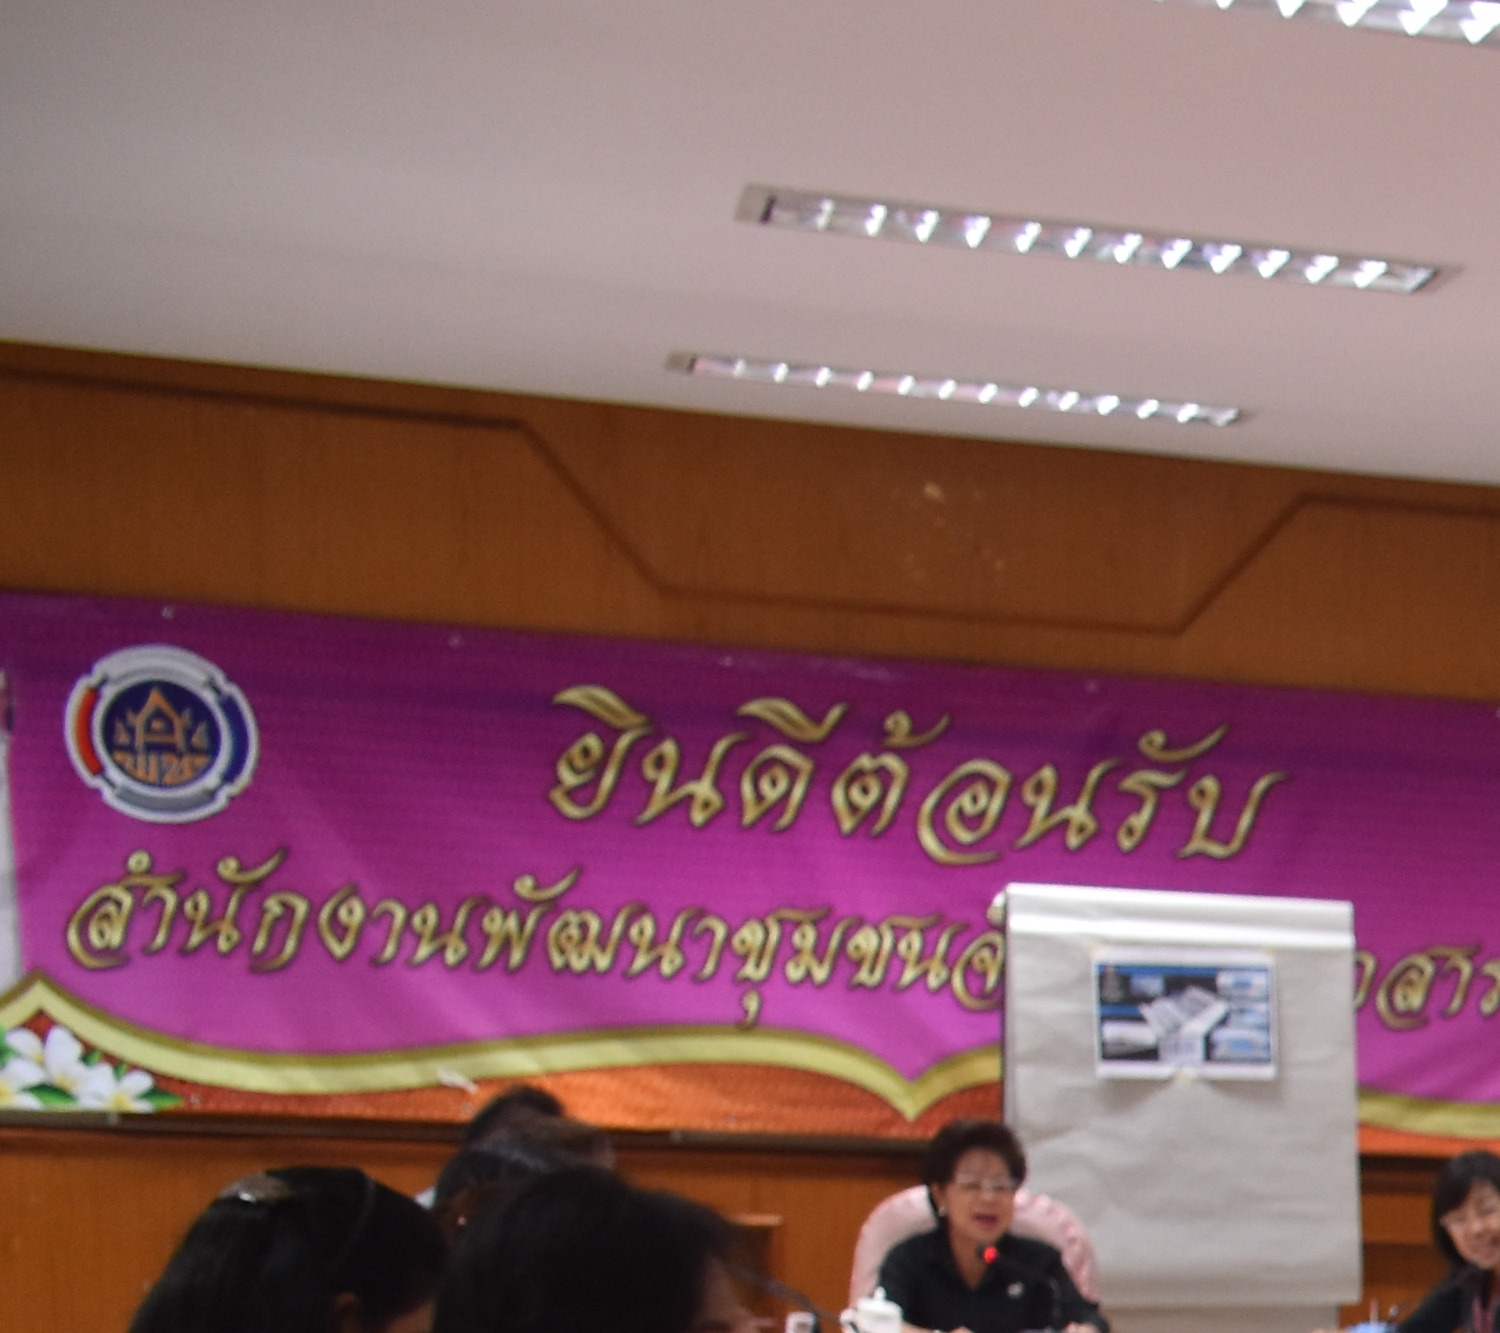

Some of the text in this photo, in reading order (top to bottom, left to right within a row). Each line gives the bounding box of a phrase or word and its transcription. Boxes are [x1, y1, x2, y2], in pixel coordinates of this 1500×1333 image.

[548, 684, 1289, 866] ยินดีต้อนรับ
[66, 847, 1006, 1029] สำนักงานพัฒนาชุมชนจ
